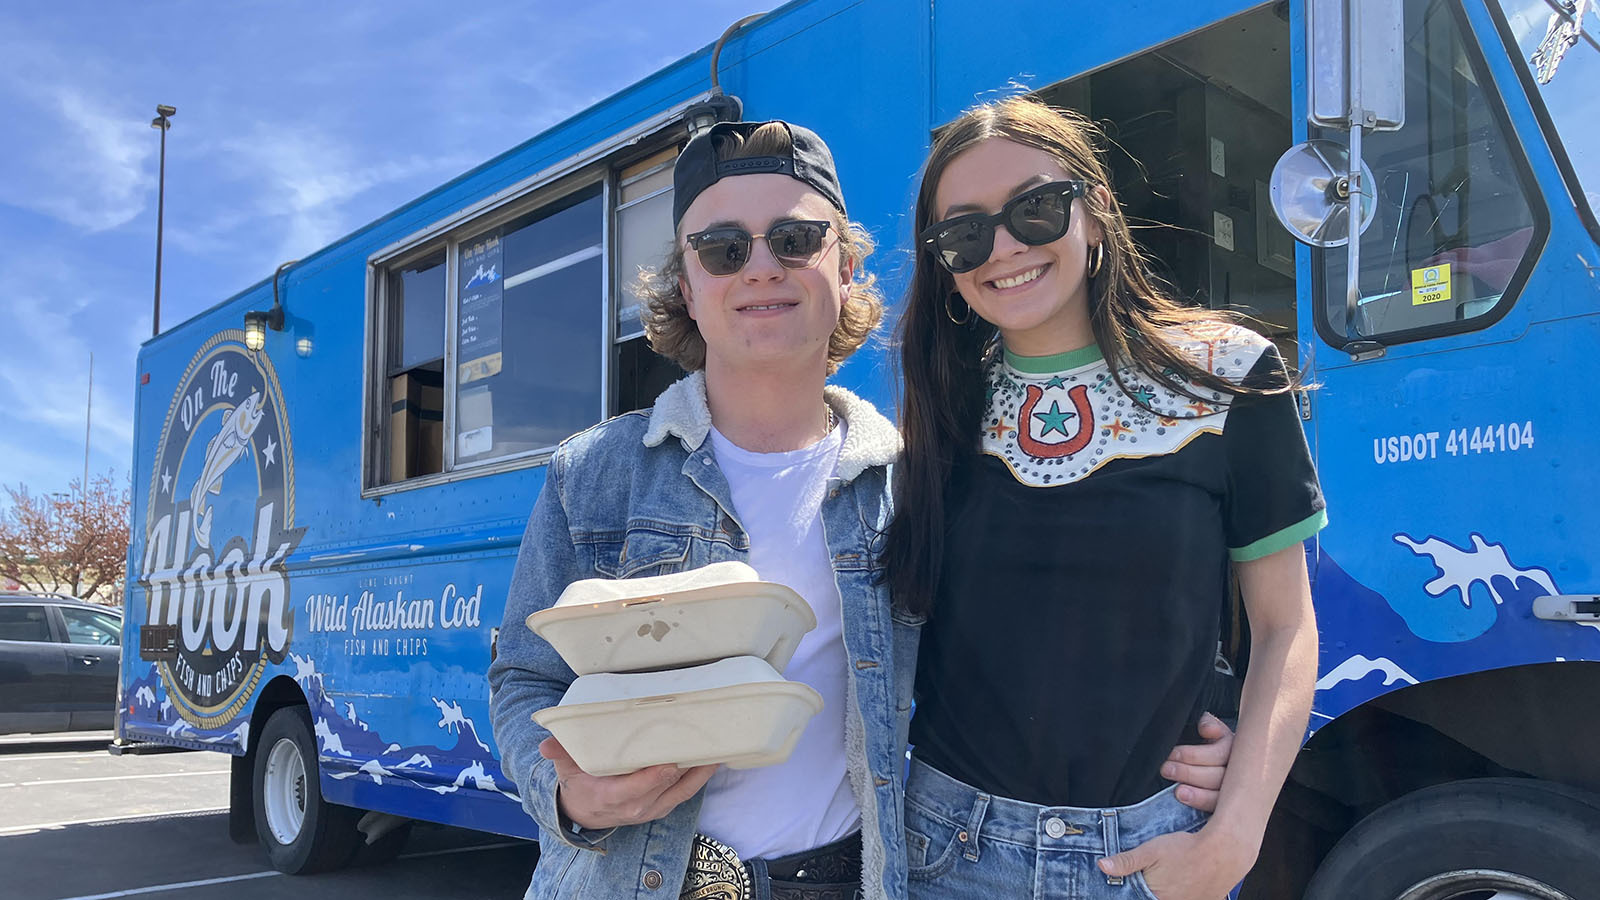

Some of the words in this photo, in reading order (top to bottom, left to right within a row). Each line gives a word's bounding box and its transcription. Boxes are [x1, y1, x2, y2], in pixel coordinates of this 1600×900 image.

[1422, 293, 1441, 302] 2020
[181, 387, 204, 432] On
[210, 360, 238, 398] The
[1373, 432, 1440, 464] USDOT
[1445, 420, 1534, 456] 4144104
[141, 502, 291, 652] Hook
[305, 594, 349, 633] Wild
[351, 589, 435, 637] Alaskan
[440, 583, 483, 629] Cod
[344, 639, 366, 656] FISH
[372, 638, 389, 656] AND
[396, 638, 428, 656] CHIPS
[176, 653, 193, 690] FISH
[196, 674, 212, 697] AND
[215, 651, 243, 694] CHIPS
